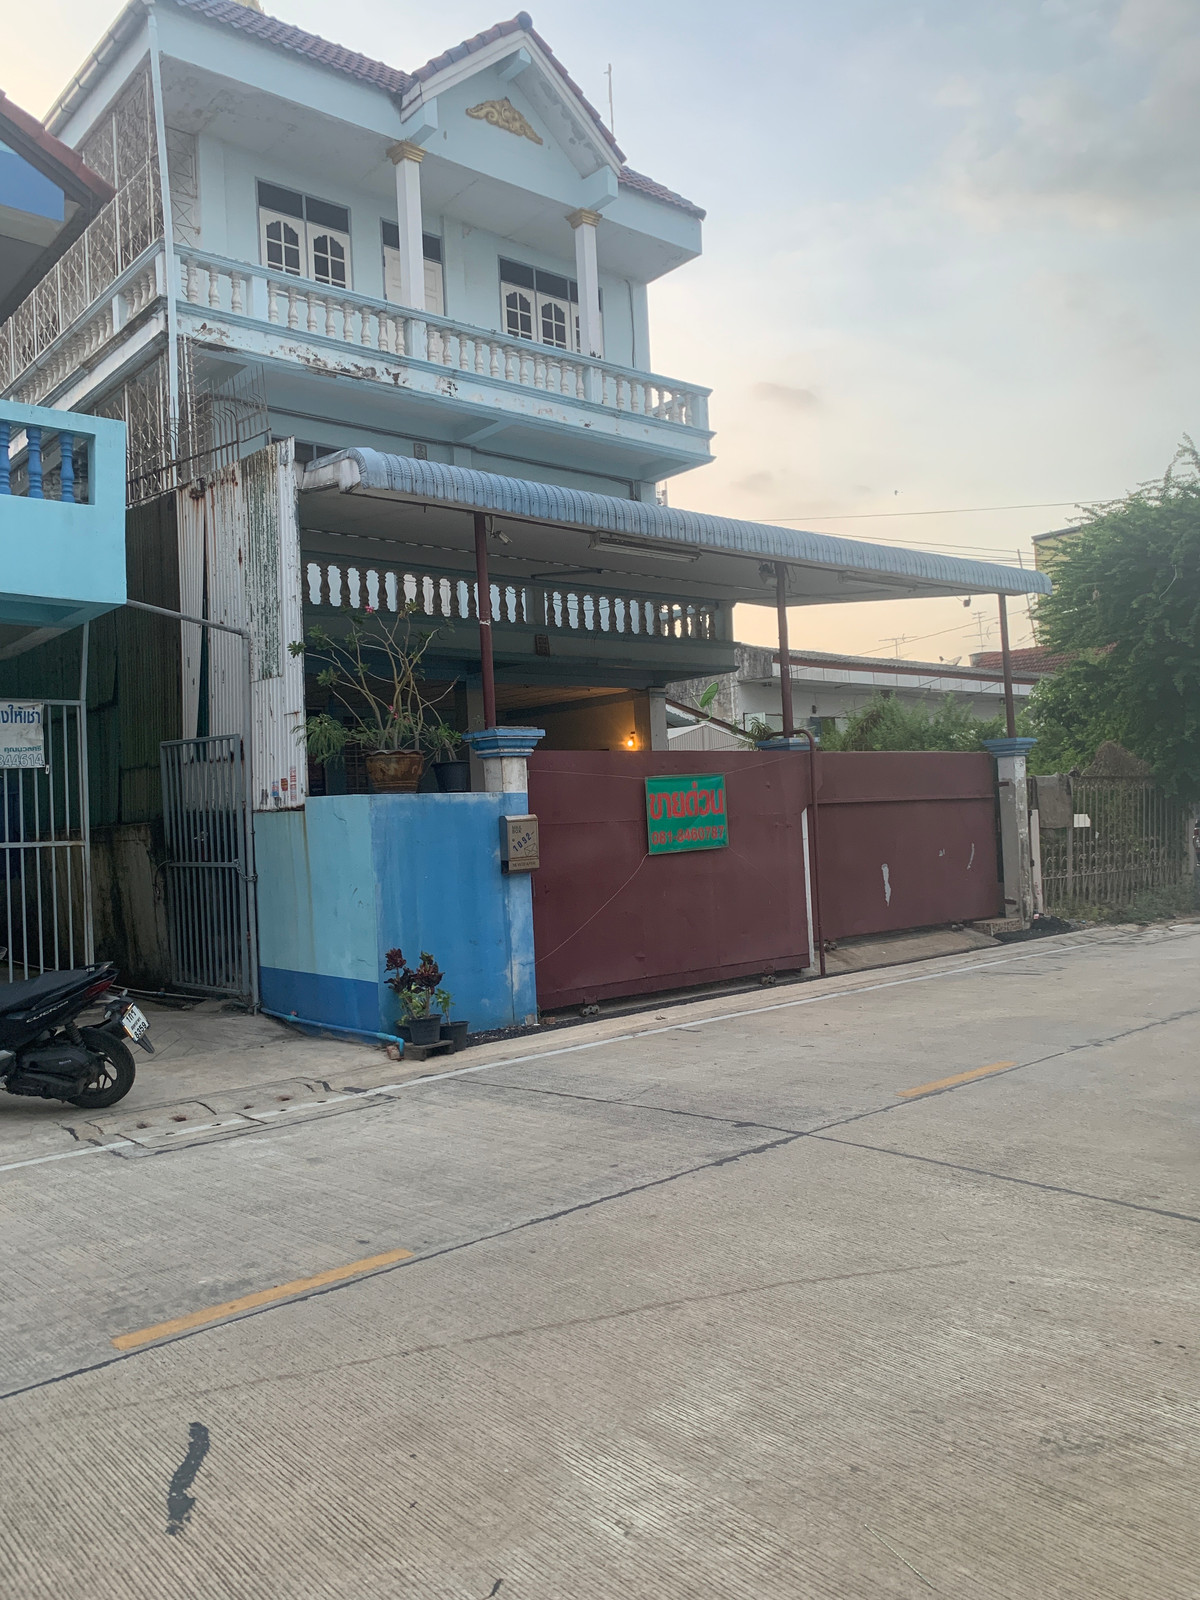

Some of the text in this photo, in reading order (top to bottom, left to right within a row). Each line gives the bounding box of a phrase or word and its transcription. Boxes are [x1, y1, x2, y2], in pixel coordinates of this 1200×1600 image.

[649, 781, 724, 820] ขายด่วน
[513, 832, 532, 852] 1092
[652, 825, 725, 845] 081-8460787
